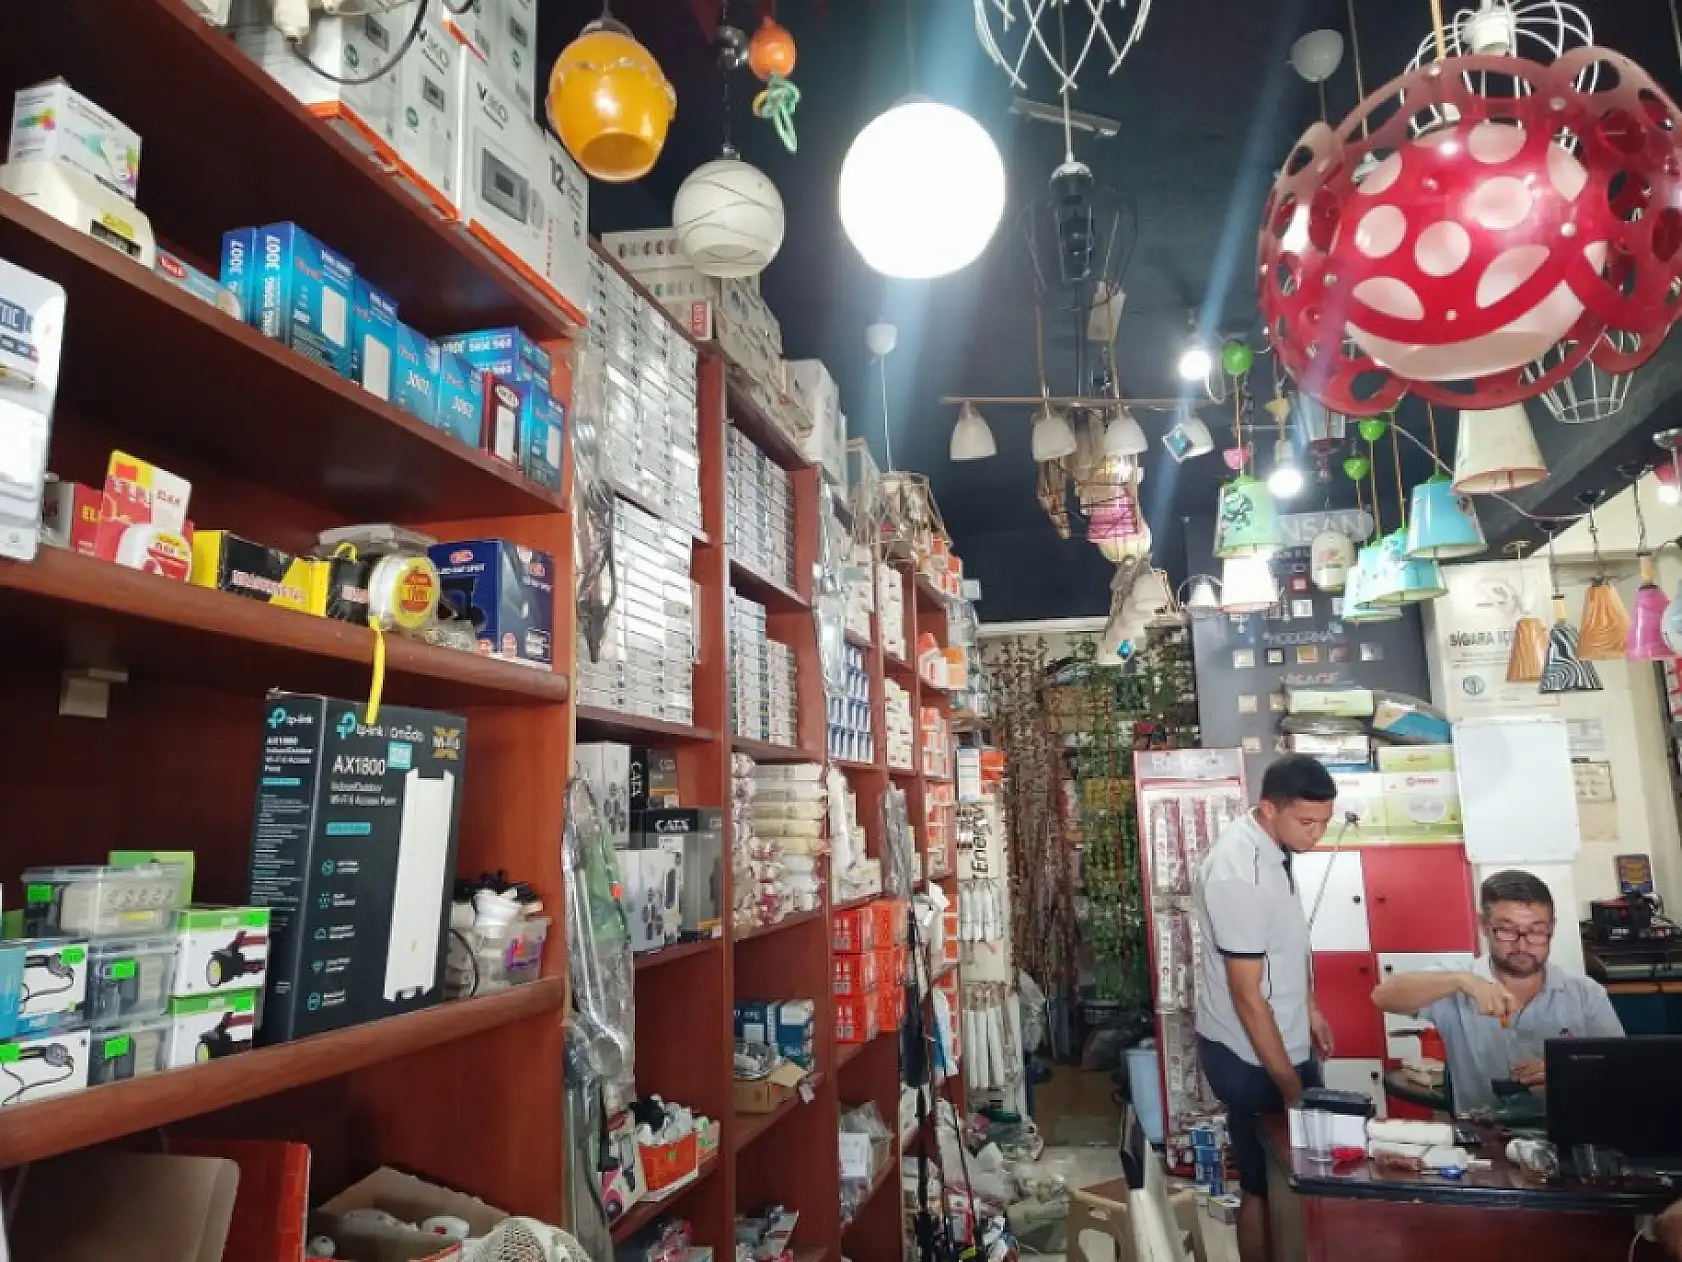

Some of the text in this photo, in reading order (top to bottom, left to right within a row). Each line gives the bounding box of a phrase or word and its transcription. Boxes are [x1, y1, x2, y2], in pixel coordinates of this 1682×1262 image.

[550, 154, 566, 195] 12
[229, 240, 243, 275] 3007
[266, 235, 280, 270] 3007
[1449, 628, 1494, 647] SİGARA
[287, 714, 313, 726] tp-link
[333, 755, 386, 776] AX1800
[654, 818, 691, 833] CATA
